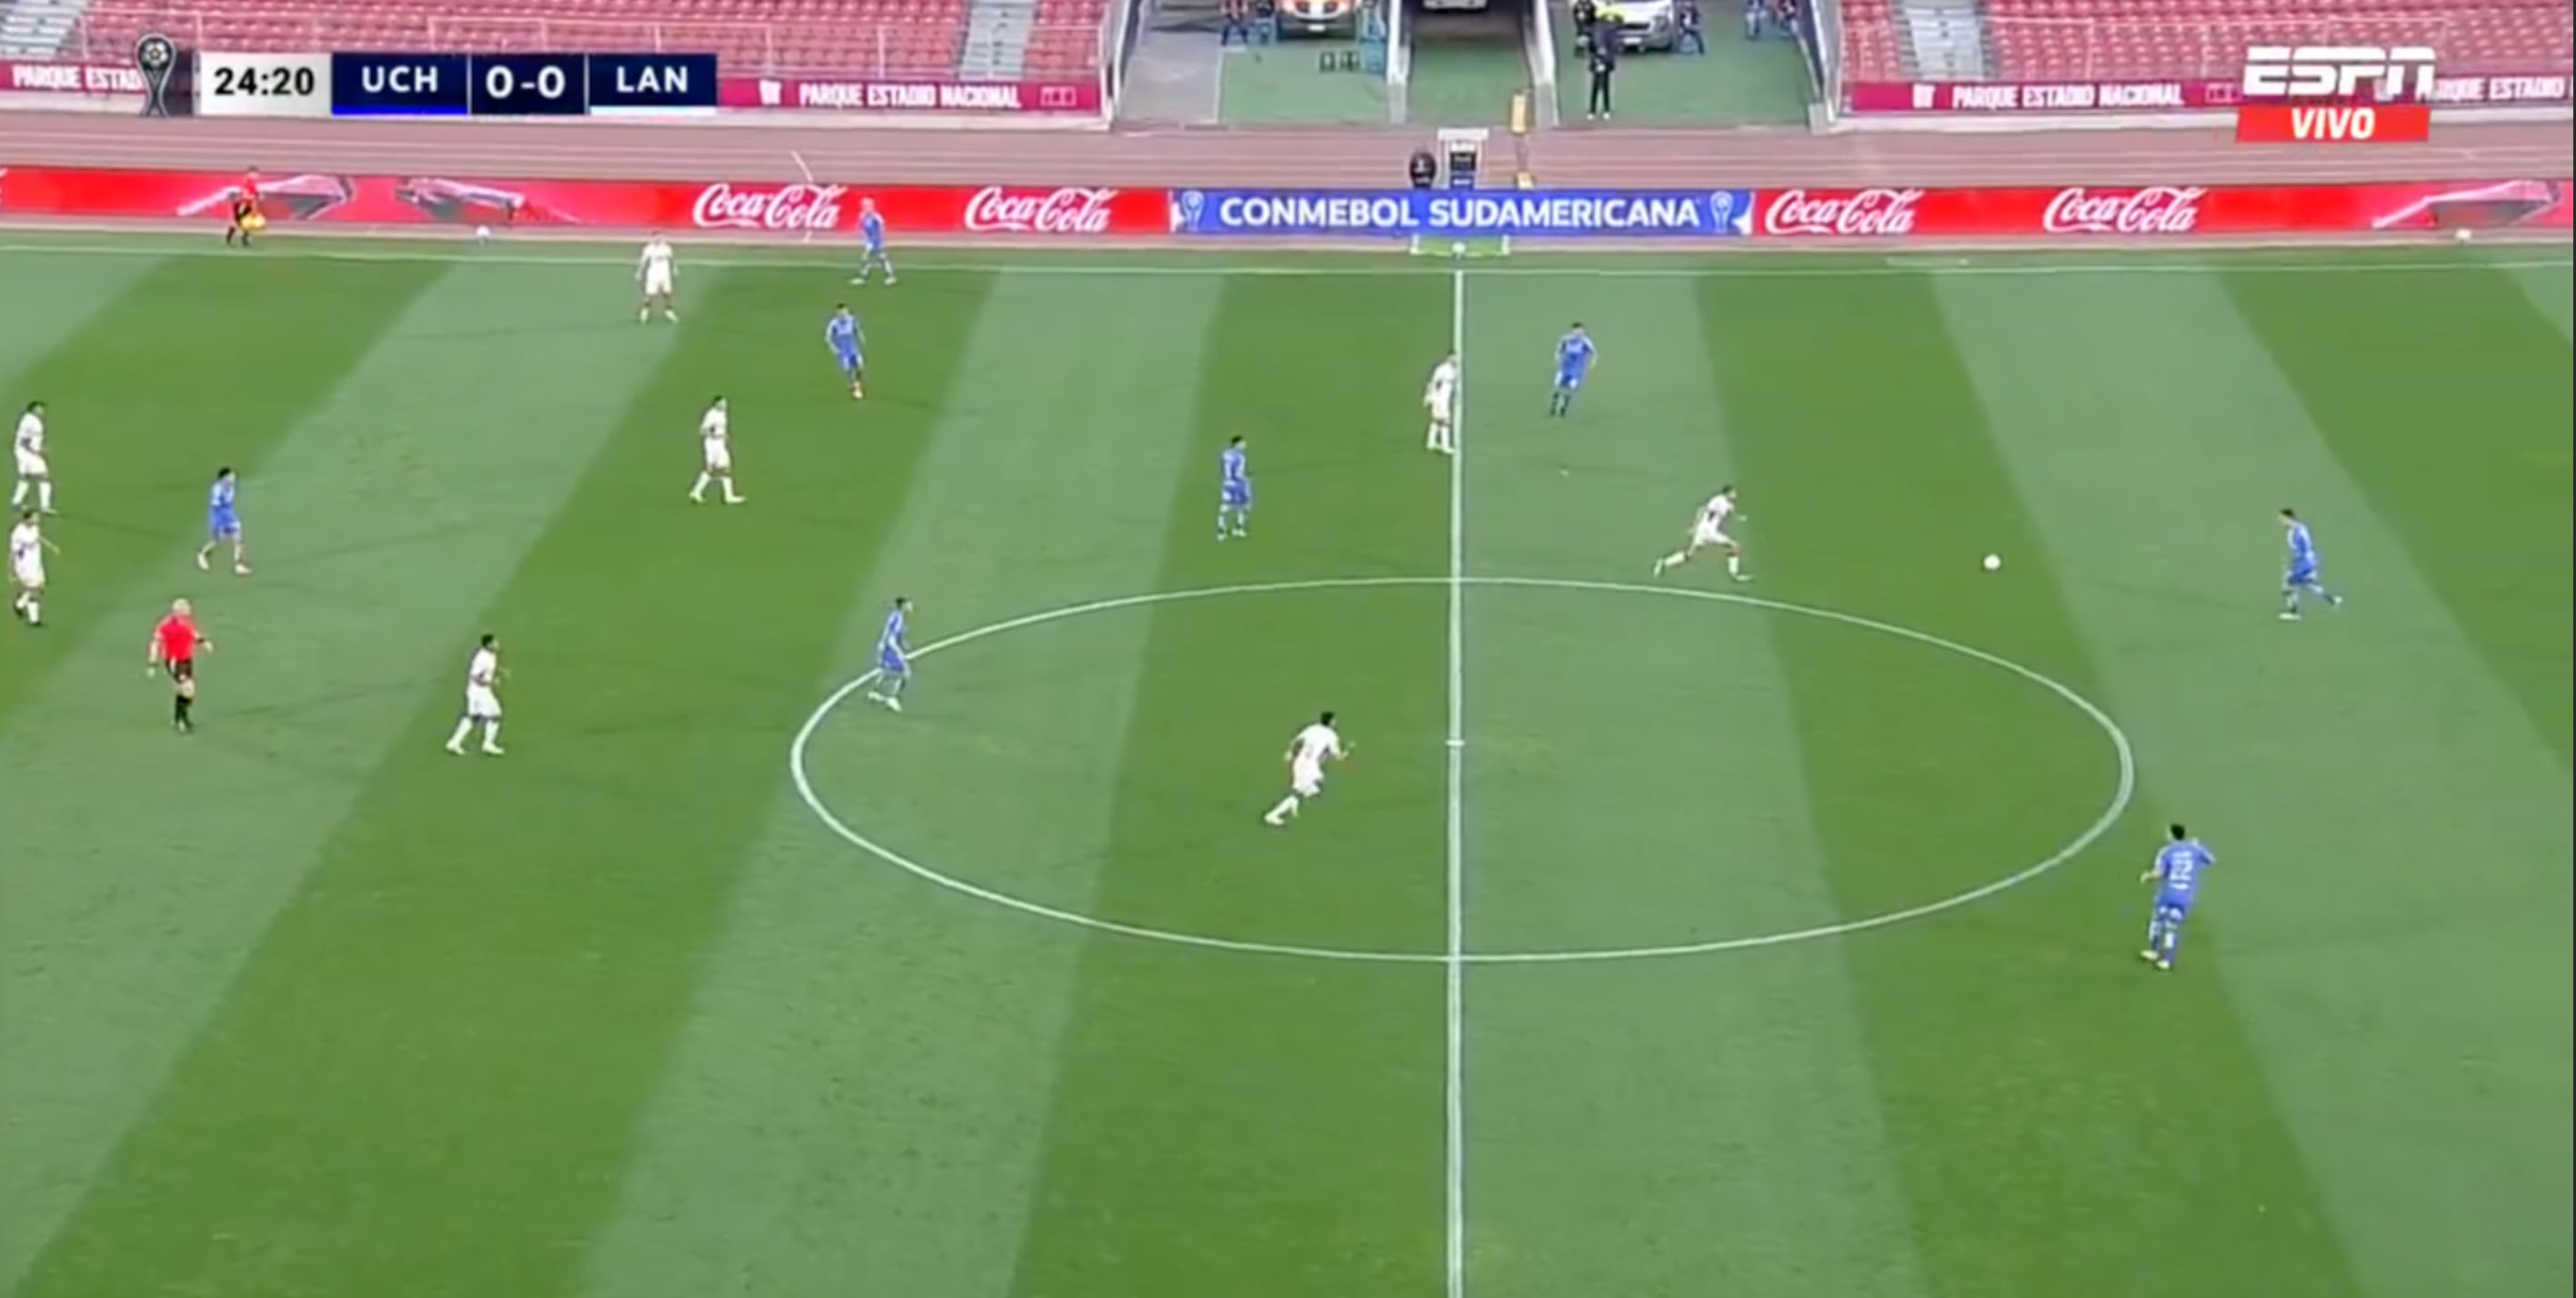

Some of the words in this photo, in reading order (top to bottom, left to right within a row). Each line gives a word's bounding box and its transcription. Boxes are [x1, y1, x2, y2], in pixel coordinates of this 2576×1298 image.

[12, 64, 82, 88] PARQUE
[2490, 77, 2565, 99] ESTADIO
[799, 83, 863, 108] PARQUE
[867, 84, 937, 107] ESTADIO
[940, 85, 1022, 108] NACIONAL
[1952, 85, 2019, 108] PARQUE
[2022, 85, 2095, 107] ESTADIO
[2100, 84, 2184, 106] NACIONAL
[1219, 197, 1418, 227] CONMEBOL
[1428, 197, 1699, 227] SUDAMERICANA
